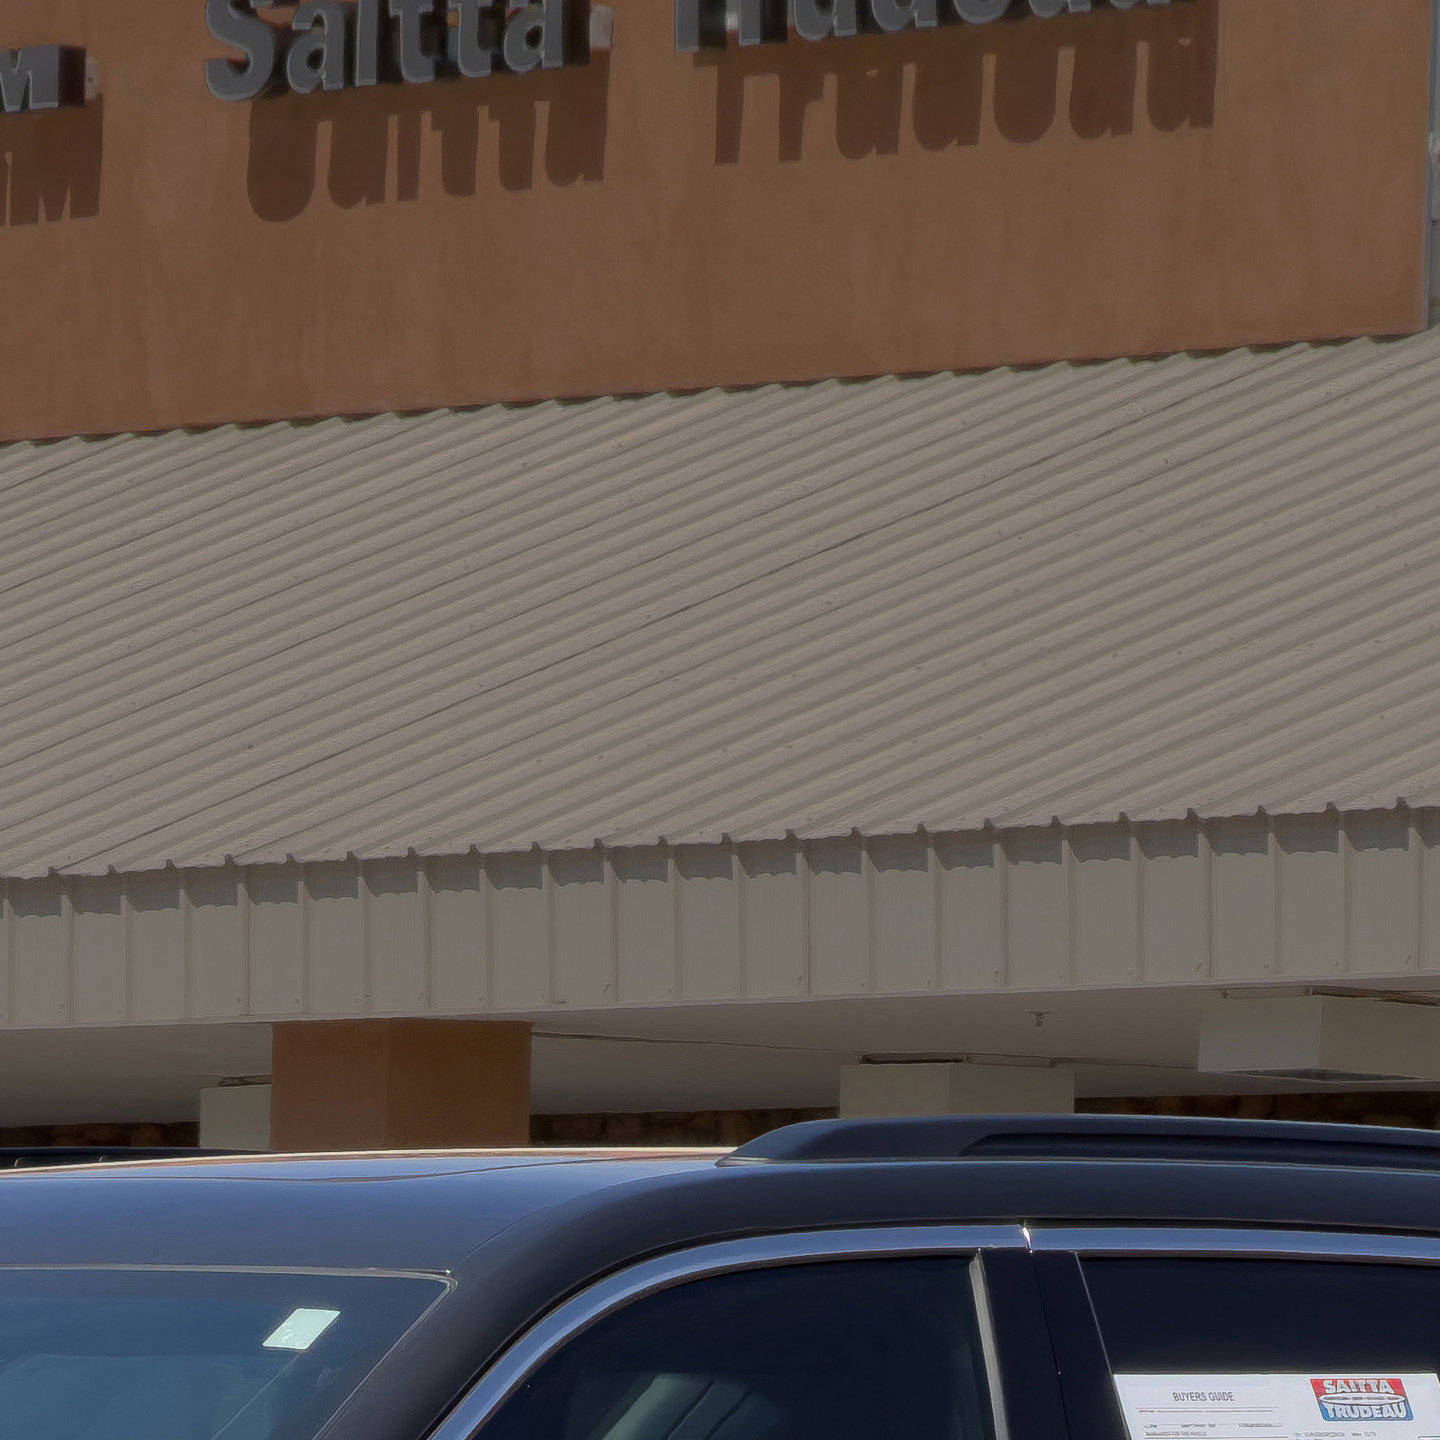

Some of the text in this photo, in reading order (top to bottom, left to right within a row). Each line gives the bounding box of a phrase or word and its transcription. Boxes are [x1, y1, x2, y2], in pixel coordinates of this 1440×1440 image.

[1322, 1380, 1395, 1394] SAITTA
[1172, 1391, 1235, 1402] BUYERS GUIDE
[1321, 1402, 1407, 1419] TRUDEAU
